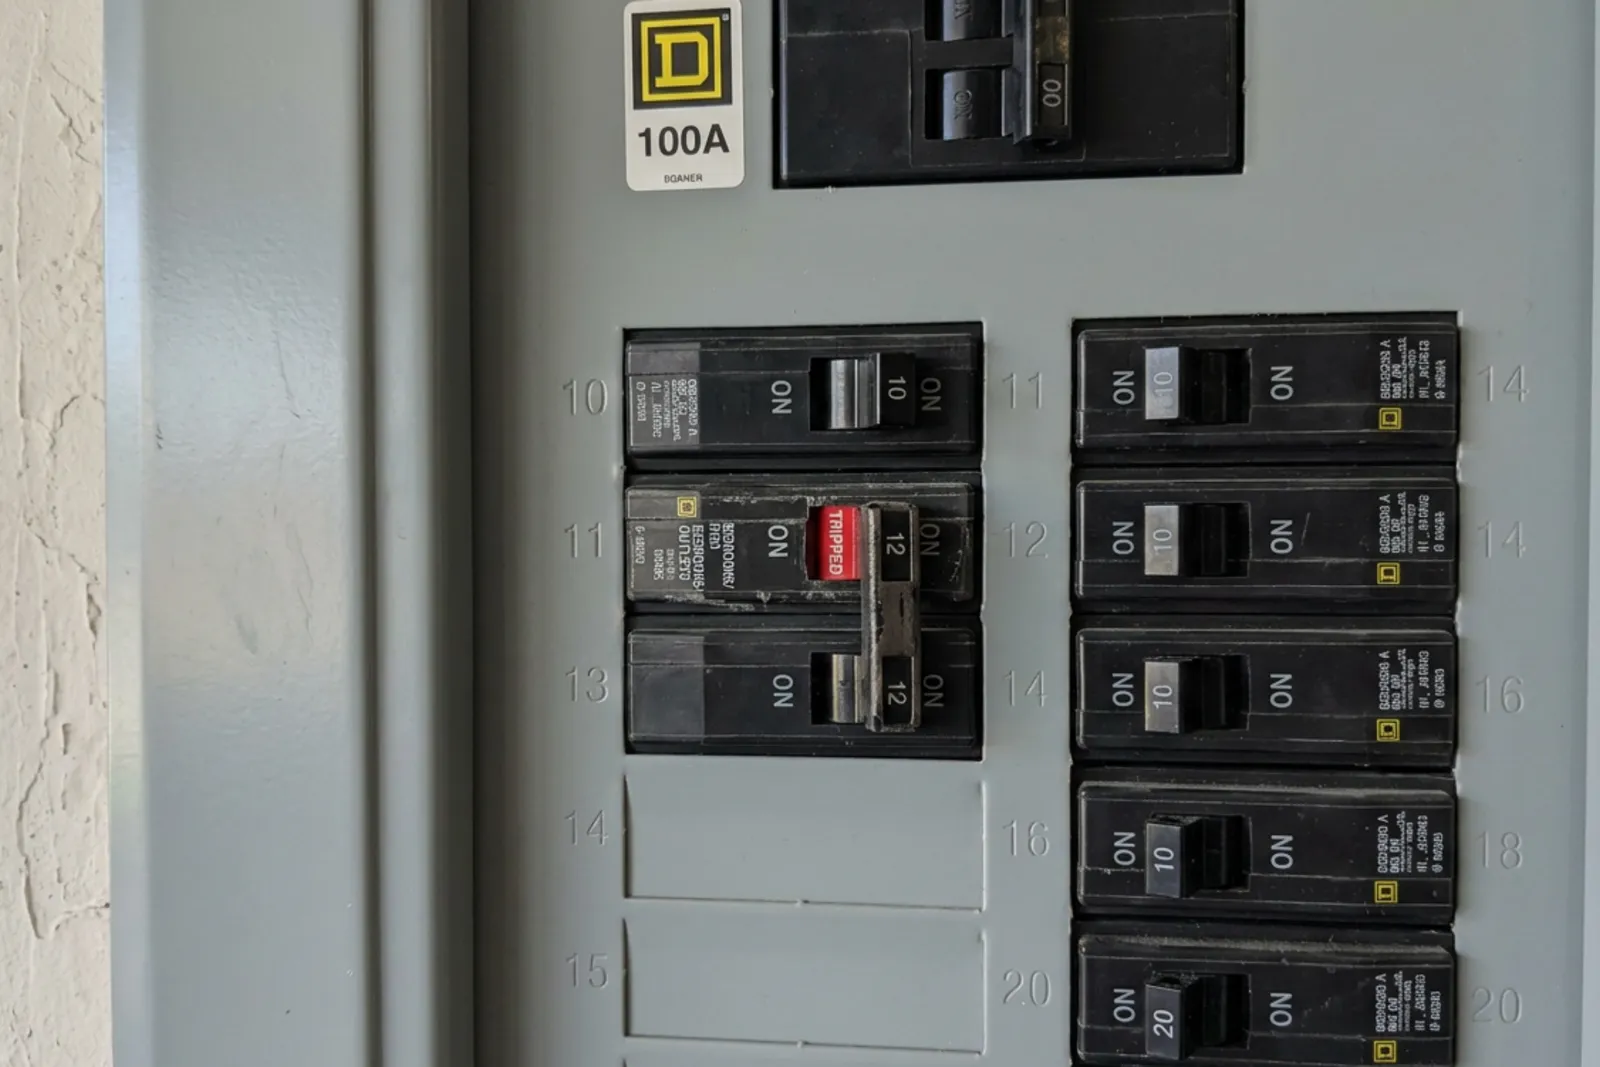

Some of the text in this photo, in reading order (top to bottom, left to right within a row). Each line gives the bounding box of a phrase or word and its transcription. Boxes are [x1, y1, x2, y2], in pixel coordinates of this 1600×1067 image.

[655, 31, 709, 87] D
[638, 123, 729, 157] 100A
[562, 378, 609, 416] 10
[771, 380, 792, 415] ON
[888, 376, 905, 400] 10
[921, 377, 941, 411] ON
[1001, 372, 1044, 409] 11
[1113, 370, 1135, 405] ON
[1153, 371, 1174, 399] 10
[1270, 365, 1293, 400] ON
[1476, 364, 1529, 403] 14
[564, 524, 603, 558] 11
[768, 525, 788, 557] ON
[825, 510, 843, 575] TRIPPED
[886, 531, 906, 555] 12
[921, 524, 939, 556] ON
[1002, 522, 1049, 558] 12
[1113, 521, 1135, 554] ON
[1153, 528, 1172, 554] 10
[1270, 519, 1293, 554] ON
[1476, 521, 1527, 558] 14
[564, 667, 608, 703] 13
[774, 674, 794, 708] ON
[888, 681, 907, 705] 12
[923, 676, 944, 708] ON
[1003, 669, 1048, 706] 14
[1112, 673, 1134, 707] ON
[1153, 684, 1173, 709] 10
[1270, 673, 1293, 708] ON
[1476, 675, 1525, 713] 16
[564, 810, 608, 846] 14
[1002, 820, 1051, 856] 16
[1114, 832, 1136, 865] ON
[1154, 847, 1174, 872] 10
[1271, 834, 1293, 869] ON
[1476, 832, 1524, 870] 18
[566, 954, 608, 989] 15
[1114, 988, 1136, 1022] ON
[1270, 992, 1293, 1026] ON
[1471, 989, 1523, 1025] 20
[1153, 1009, 1174, 1038] 20
